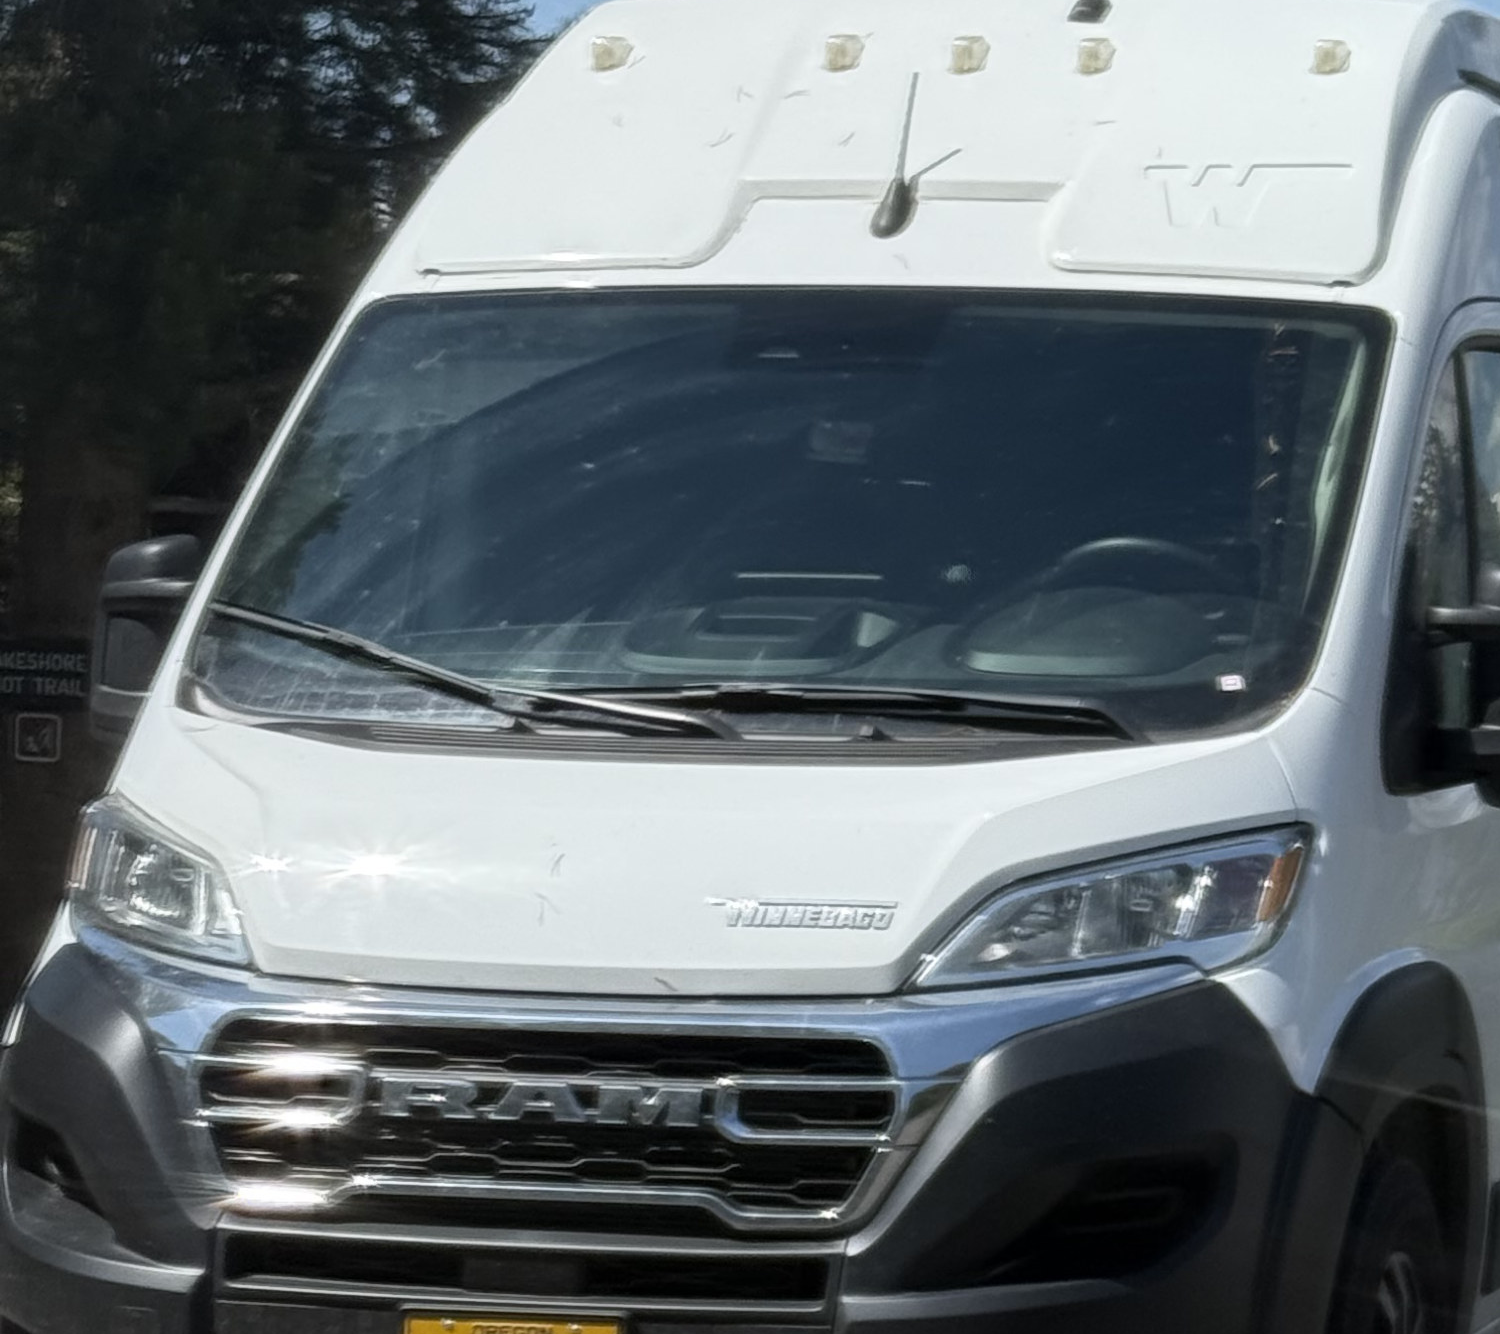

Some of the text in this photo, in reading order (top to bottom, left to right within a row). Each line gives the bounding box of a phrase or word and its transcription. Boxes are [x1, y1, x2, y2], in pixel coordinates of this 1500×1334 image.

[32, 677, 87, 697] TRAIL
[708, 898, 896, 931] WINNEBAGO
[380, 1077, 704, 1127] RAM
